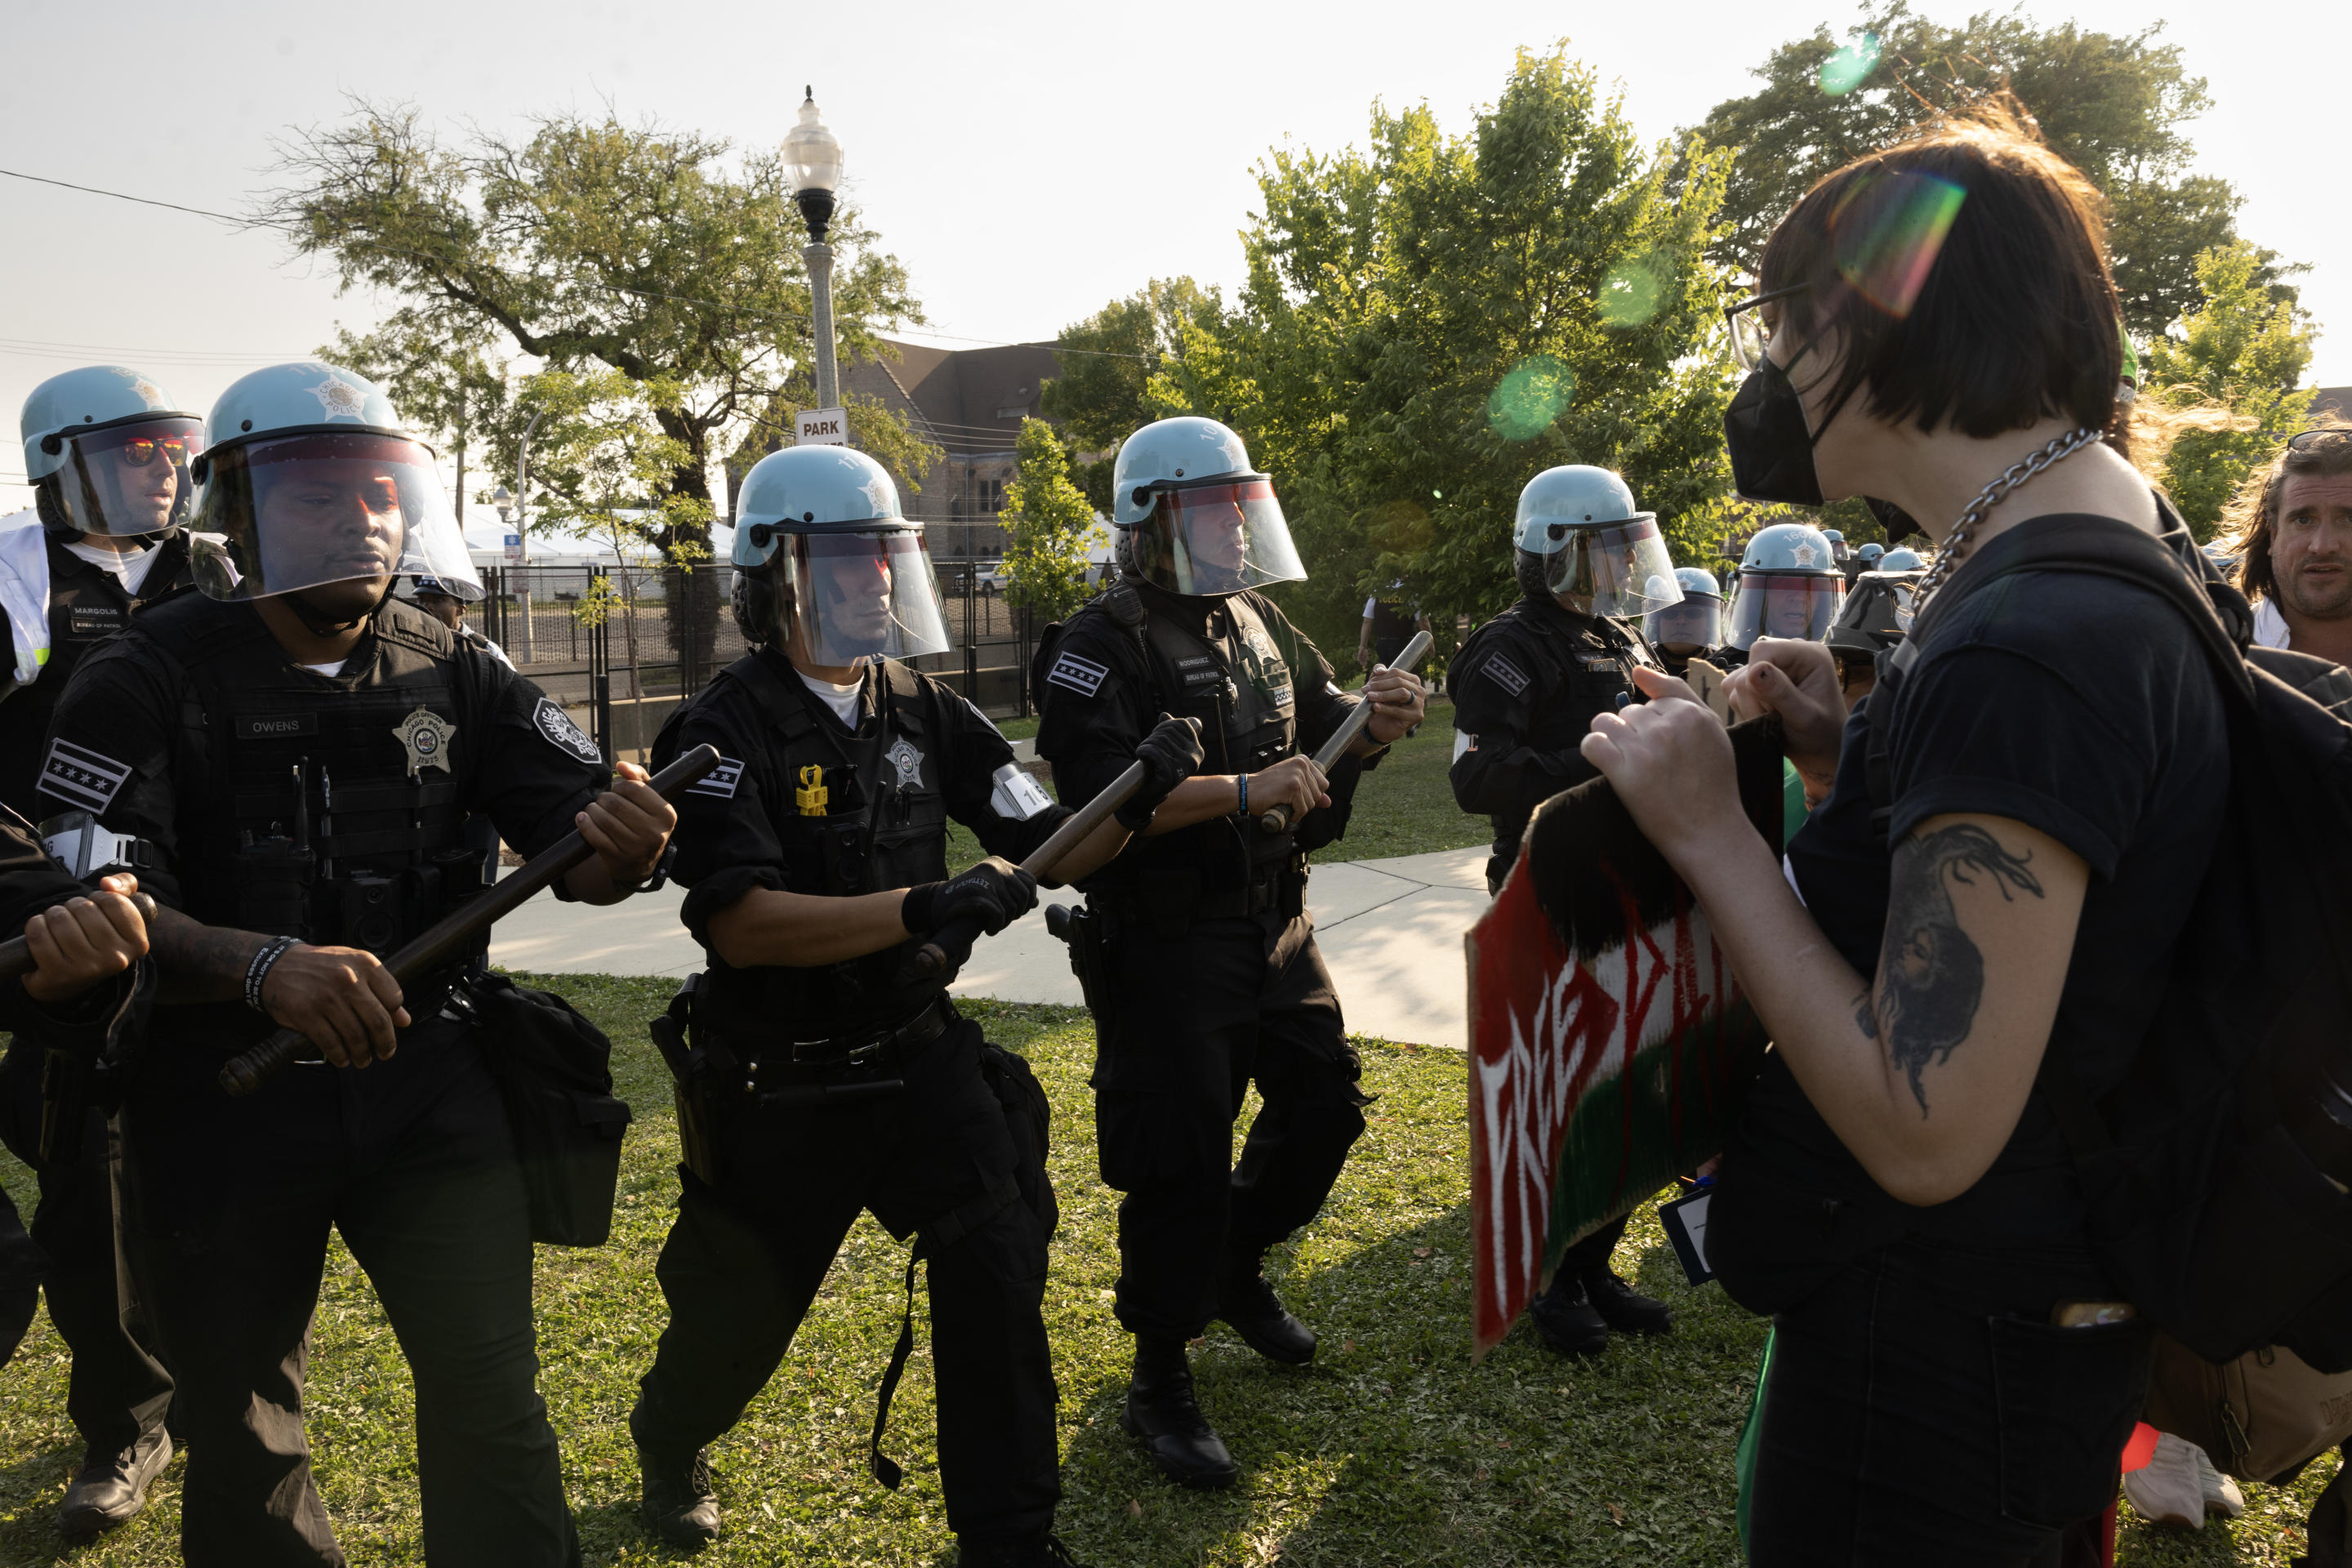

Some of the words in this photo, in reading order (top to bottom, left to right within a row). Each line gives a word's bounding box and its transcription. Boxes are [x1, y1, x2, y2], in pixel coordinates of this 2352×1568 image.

[319, 381, 357, 395] CHICAGO
[326, 400, 360, 414] POLICE
[804, 421, 840, 436] PARK
[1178, 657, 1209, 667] RODRIGUEZ
[252, 720, 300, 733] OWENS
[407, 719, 425, 747] CHICAGO
[428, 719, 446, 745] POLICE
[247, 947, 269, 977] Excuses
[266, 954, 276, 962] OK
[259, 962, 270, 976] NOT
[255, 976, 261, 985] TO
[1477, 943, 1588, 1323] FREE
